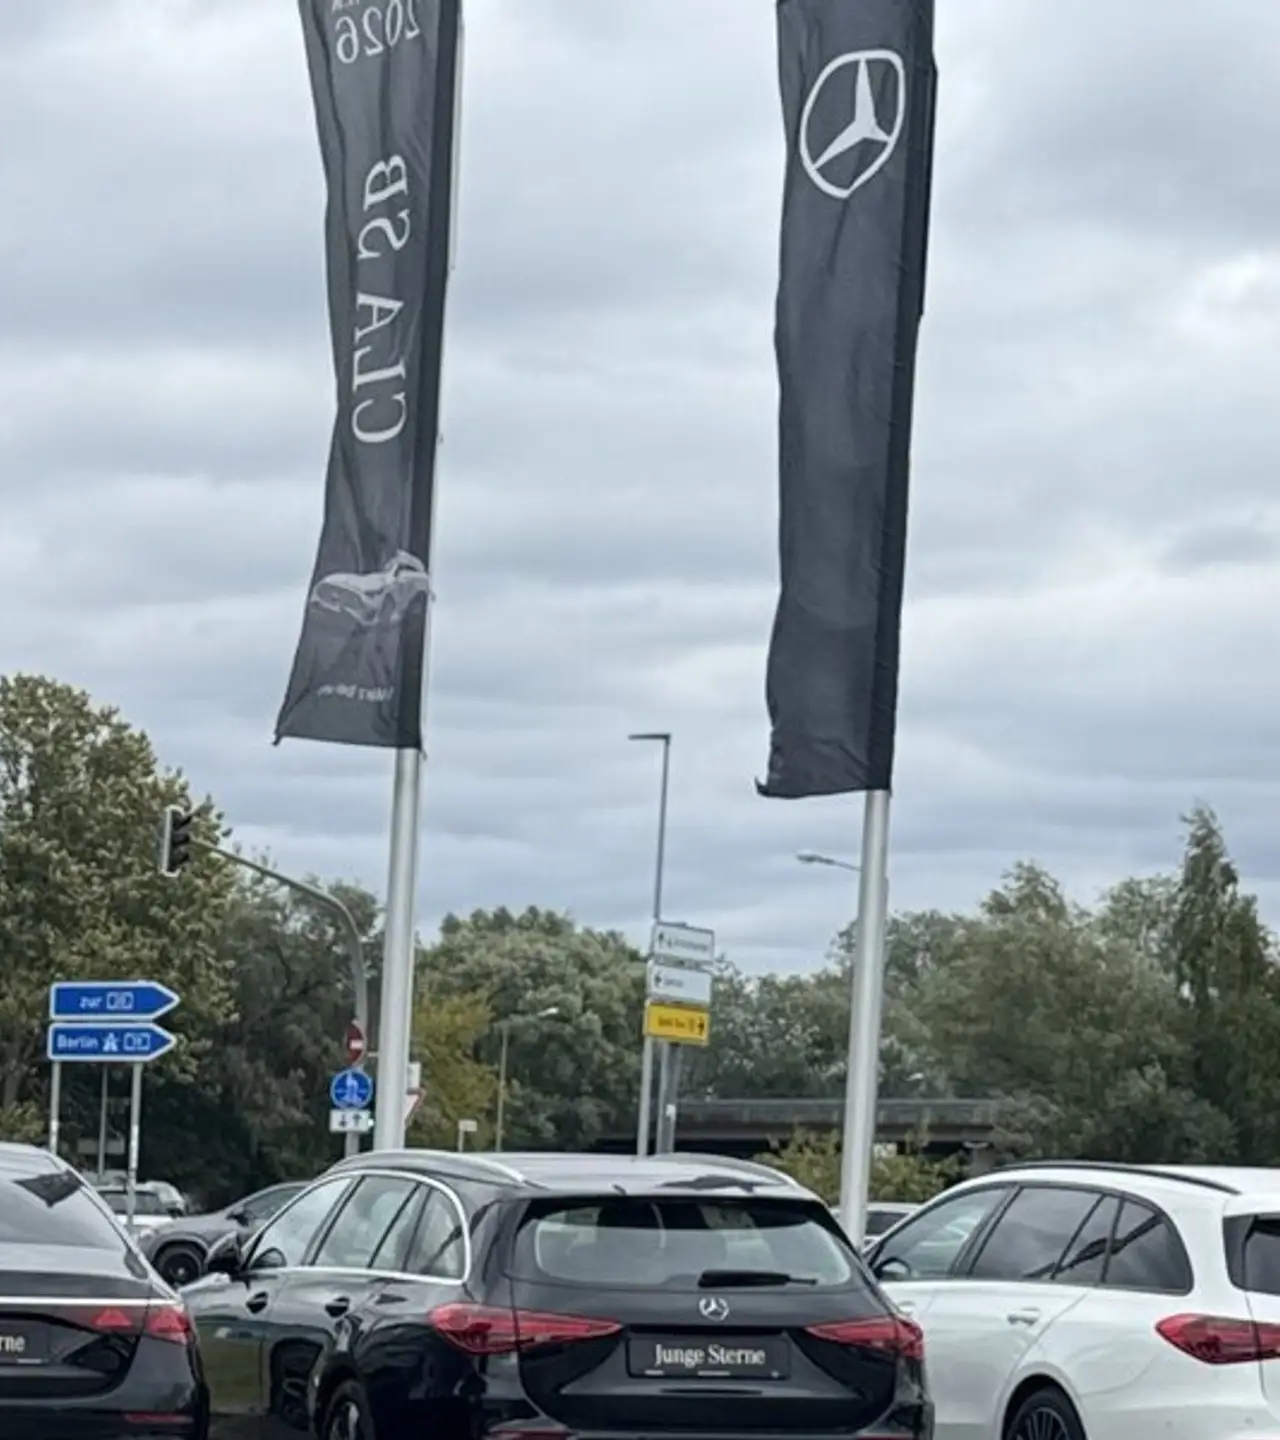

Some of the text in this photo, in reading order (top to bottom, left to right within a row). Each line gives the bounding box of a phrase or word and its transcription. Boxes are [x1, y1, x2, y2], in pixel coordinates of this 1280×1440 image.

[57, 1033, 99, 1051] Berlin
[654, 1343, 765, 1368] Junge Sterne
